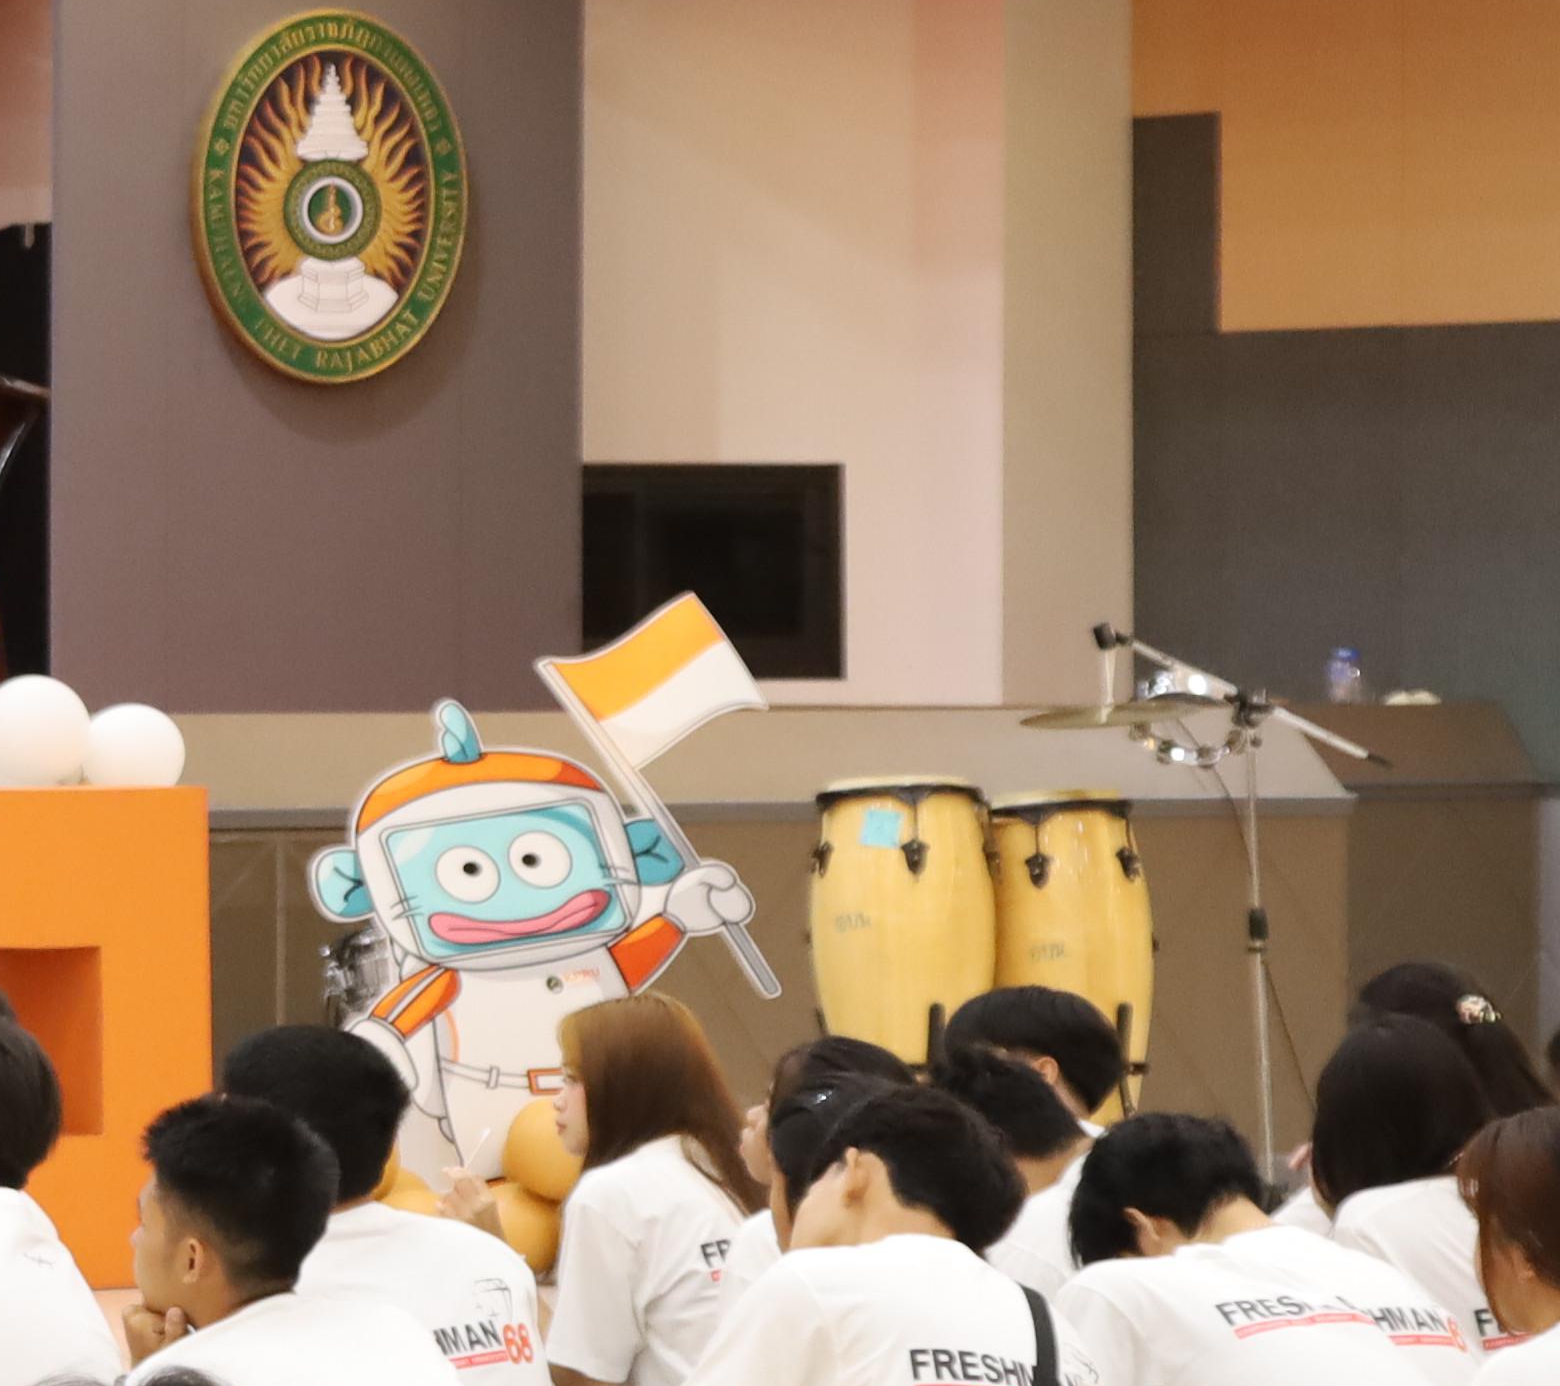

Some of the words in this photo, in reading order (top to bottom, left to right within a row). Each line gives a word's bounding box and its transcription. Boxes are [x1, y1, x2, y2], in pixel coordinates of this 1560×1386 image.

[316, 310, 418, 372] RAJABHAT
[418, 171, 458, 301] UNIVERSITY
[1370, 1306, 1449, 1332] HMAN
[502, 1322, 534, 1365] 68
